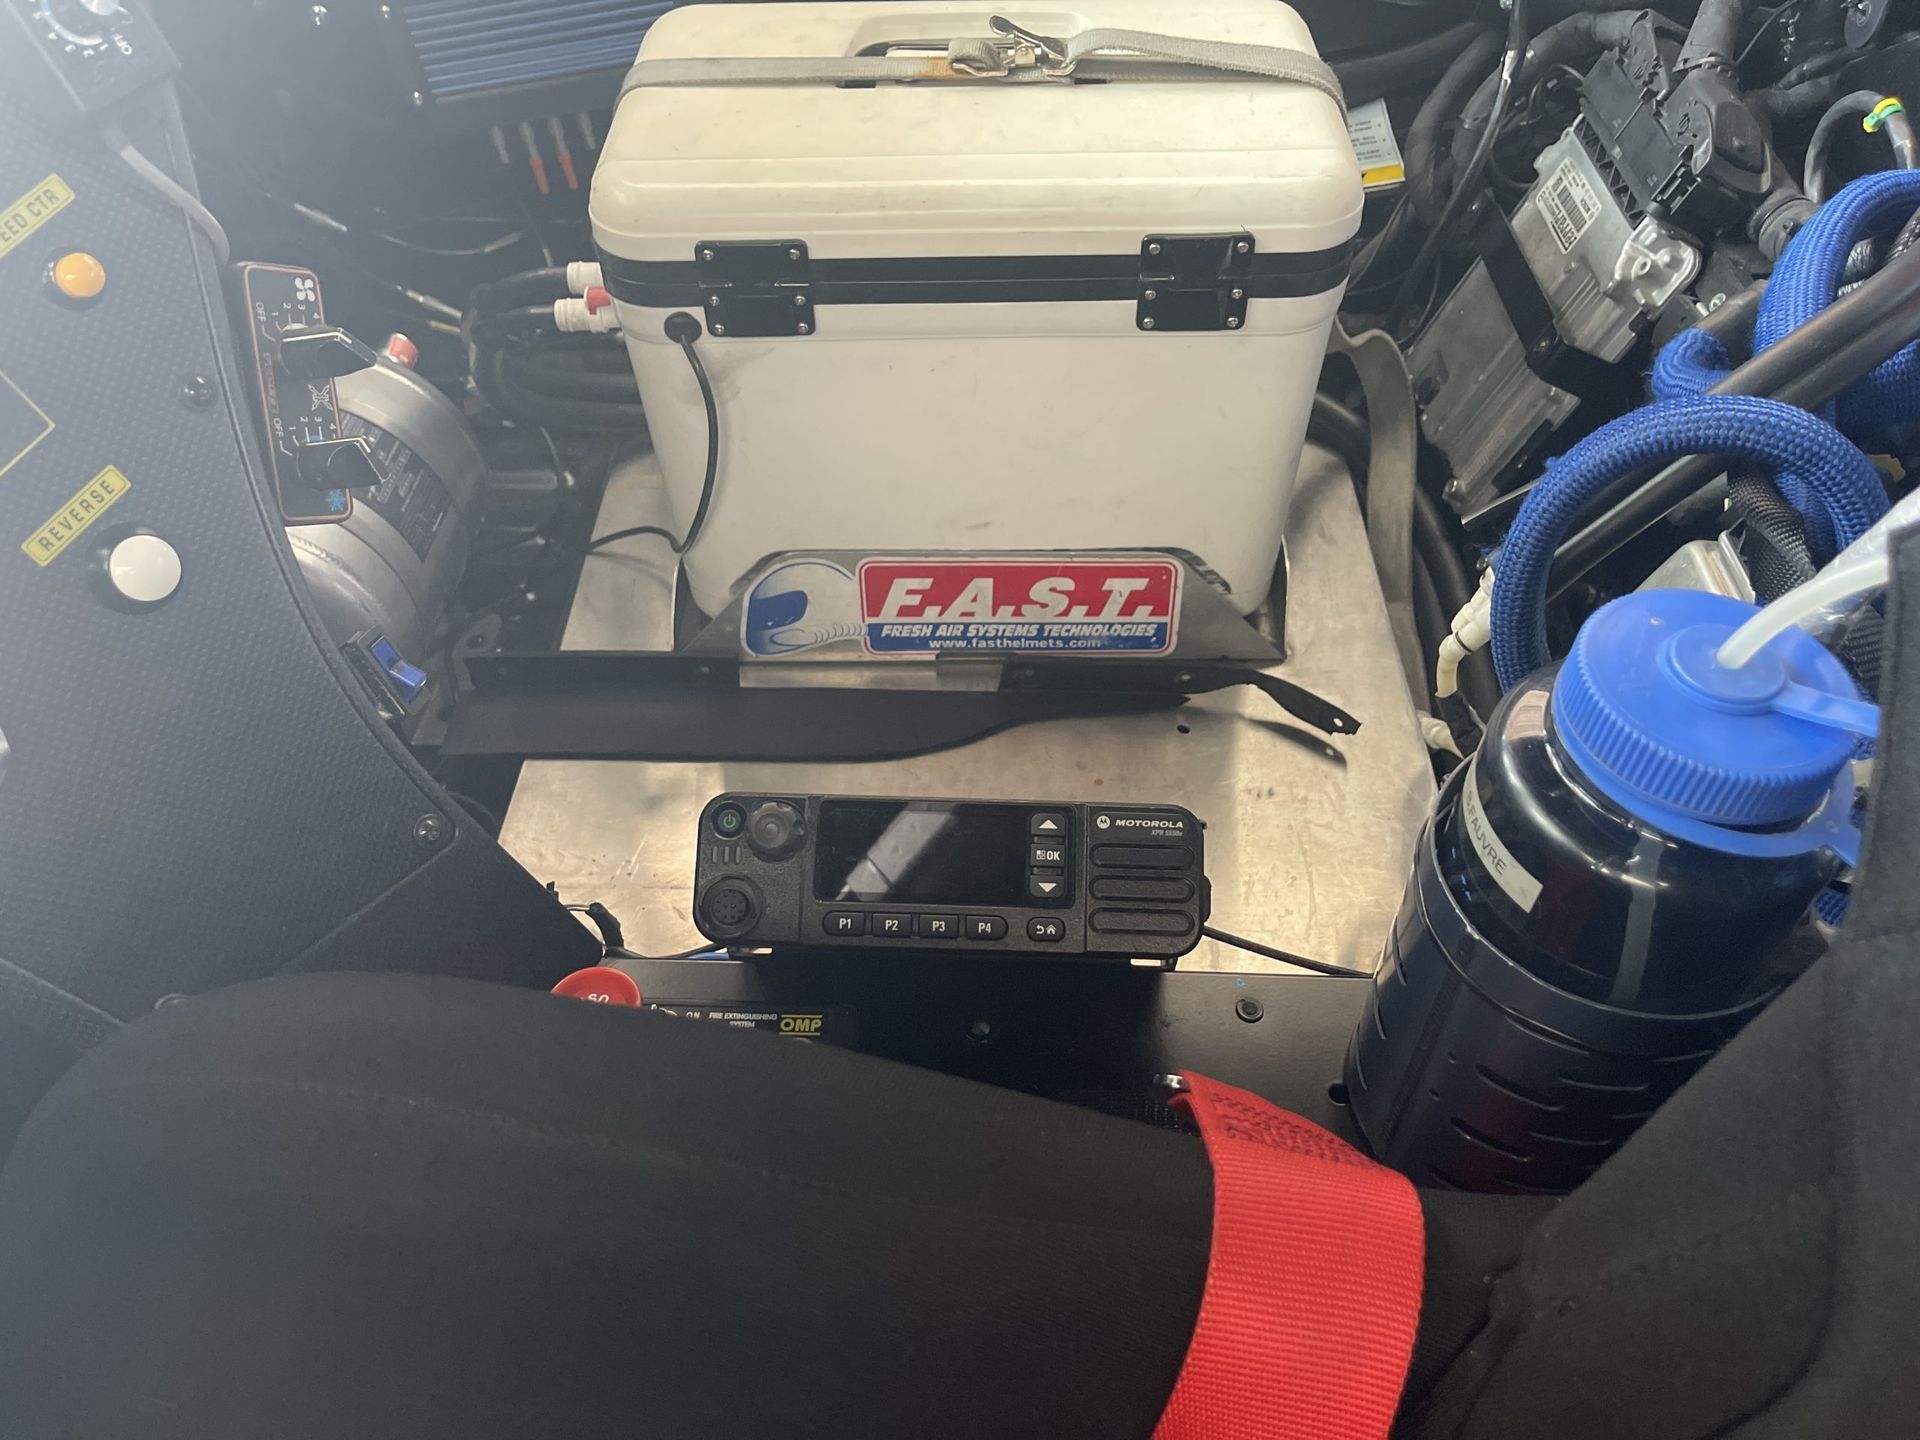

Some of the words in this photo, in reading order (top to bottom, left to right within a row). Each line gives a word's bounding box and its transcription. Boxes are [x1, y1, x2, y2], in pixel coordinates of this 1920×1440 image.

[27, 189, 60, 217] CTR
[255, 302, 267, 322] OFF
[273, 418, 284, 437] OFF
[38, 480, 115, 551] REVERSE
[876, 577, 1155, 618] F.A.S.T.
[881, 624, 931, 637] FRESH
[935, 624, 962, 637] AIR
[966, 624, 1038, 637] SYSTEMS
[1041, 624, 1158, 637] TECHNOLOGIES
[929, 637, 1101, 649] www.fasthelmets.com
[1115, 819, 1184, 829] MOTOROLA
[1046, 850, 1061, 861] OK
[839, 918, 852, 929] P1
[885, 919, 899, 931] P2
[932, 921, 946, 932] P3
[978, 922, 992, 933] P4
[724, 1012, 778, 1021] EXTINGUISHING
[780, 1018, 823, 1032] OMP
